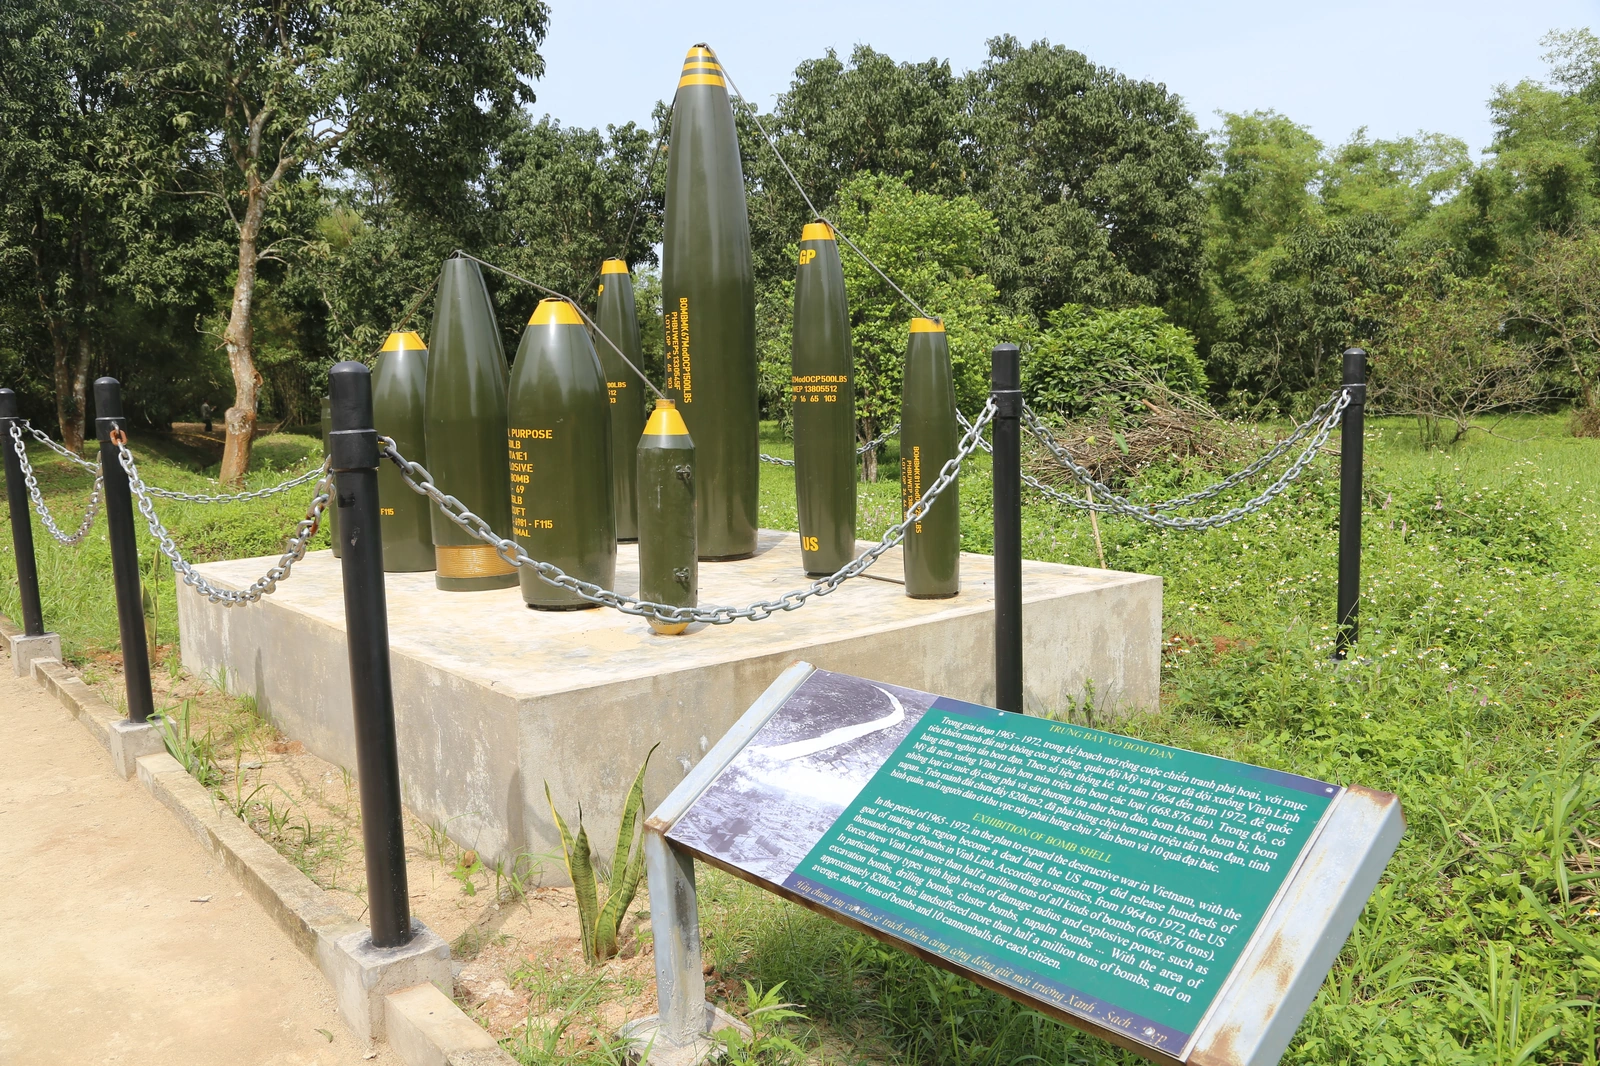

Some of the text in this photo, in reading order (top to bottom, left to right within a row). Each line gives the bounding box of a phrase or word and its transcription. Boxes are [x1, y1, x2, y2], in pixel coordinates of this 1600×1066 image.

[799, 249, 816, 265] GP
[823, 394, 837, 402] 103
[511, 428, 553, 439] PURPOSE
[516, 486, 525, 494] 69
[534, 519, 553, 529] F115
[802, 536, 819, 551] US
[972, 812, 1114, 864] EXHIBITION OF BOMB SHELL
[874, 796, 884, 805] In
[882, 799, 895, 809] the
[892, 804, 920, 816] period
[926, 812, 947, 825] 1965
[949, 820, 971, 834] 1972,
[970, 826, 981, 836] in
[979, 830, 994, 841] the
[991, 835, 1013, 847] plan
[1012, 841, 1022, 850] to
[1021, 845, 1056, 861] expand
[1053, 854, 1069, 866] the
[1067, 859, 1120, 882] destructive
[1120, 876, 1140, 888] war
[1138, 880, 1150, 892] in
[1153, 884, 1195, 908] Vietnam,
[1199, 901, 1223, 915] with
[1223, 908, 1242, 921] the
[859, 806, 879, 816] goal
[887, 814, 916, 830] making
[916, 822, 931, 833] this
[931, 829, 958, 842] region
[958, 835, 991, 853] become
[999, 850, 1023, 864] dead
[1022, 857, 1045, 873] land,
[1047, 866, 1063, 878] the
[1064, 871, 1082, 884] US
[1081, 879, 1109, 894] army
[1109, 887, 1129, 899] did
[1128, 894, 1166, 912] release
[1167, 904, 1218, 929] hundreds
[1220, 924, 1238, 934] of
[845, 823, 868, 837] forces
[866, 831, 888, 844] threw
[888, 837, 906, 851] Vinh
[905, 844, 925, 857] Linh
[923, 852, 945, 865] more
[944, 858, 963, 871] than
[962, 864, 984, 877] half
[986, 875, 1018, 891] million
[1018, 885, 1038, 898] tons
[1038, 893, 1053, 902] of
[1048, 896, 1064, 907] all
[1062, 899, 1090, 917] kinds
[1089, 911, 1106, 921] of
[1101, 913, 1137, 933] bombs
[1136, 926, 1186, 950] (668,876
[1185, 944, 1215, 961] tons).
[836, 833, 1209, 975] In particular, many types with high levels of damage radius and explosive power, such as
